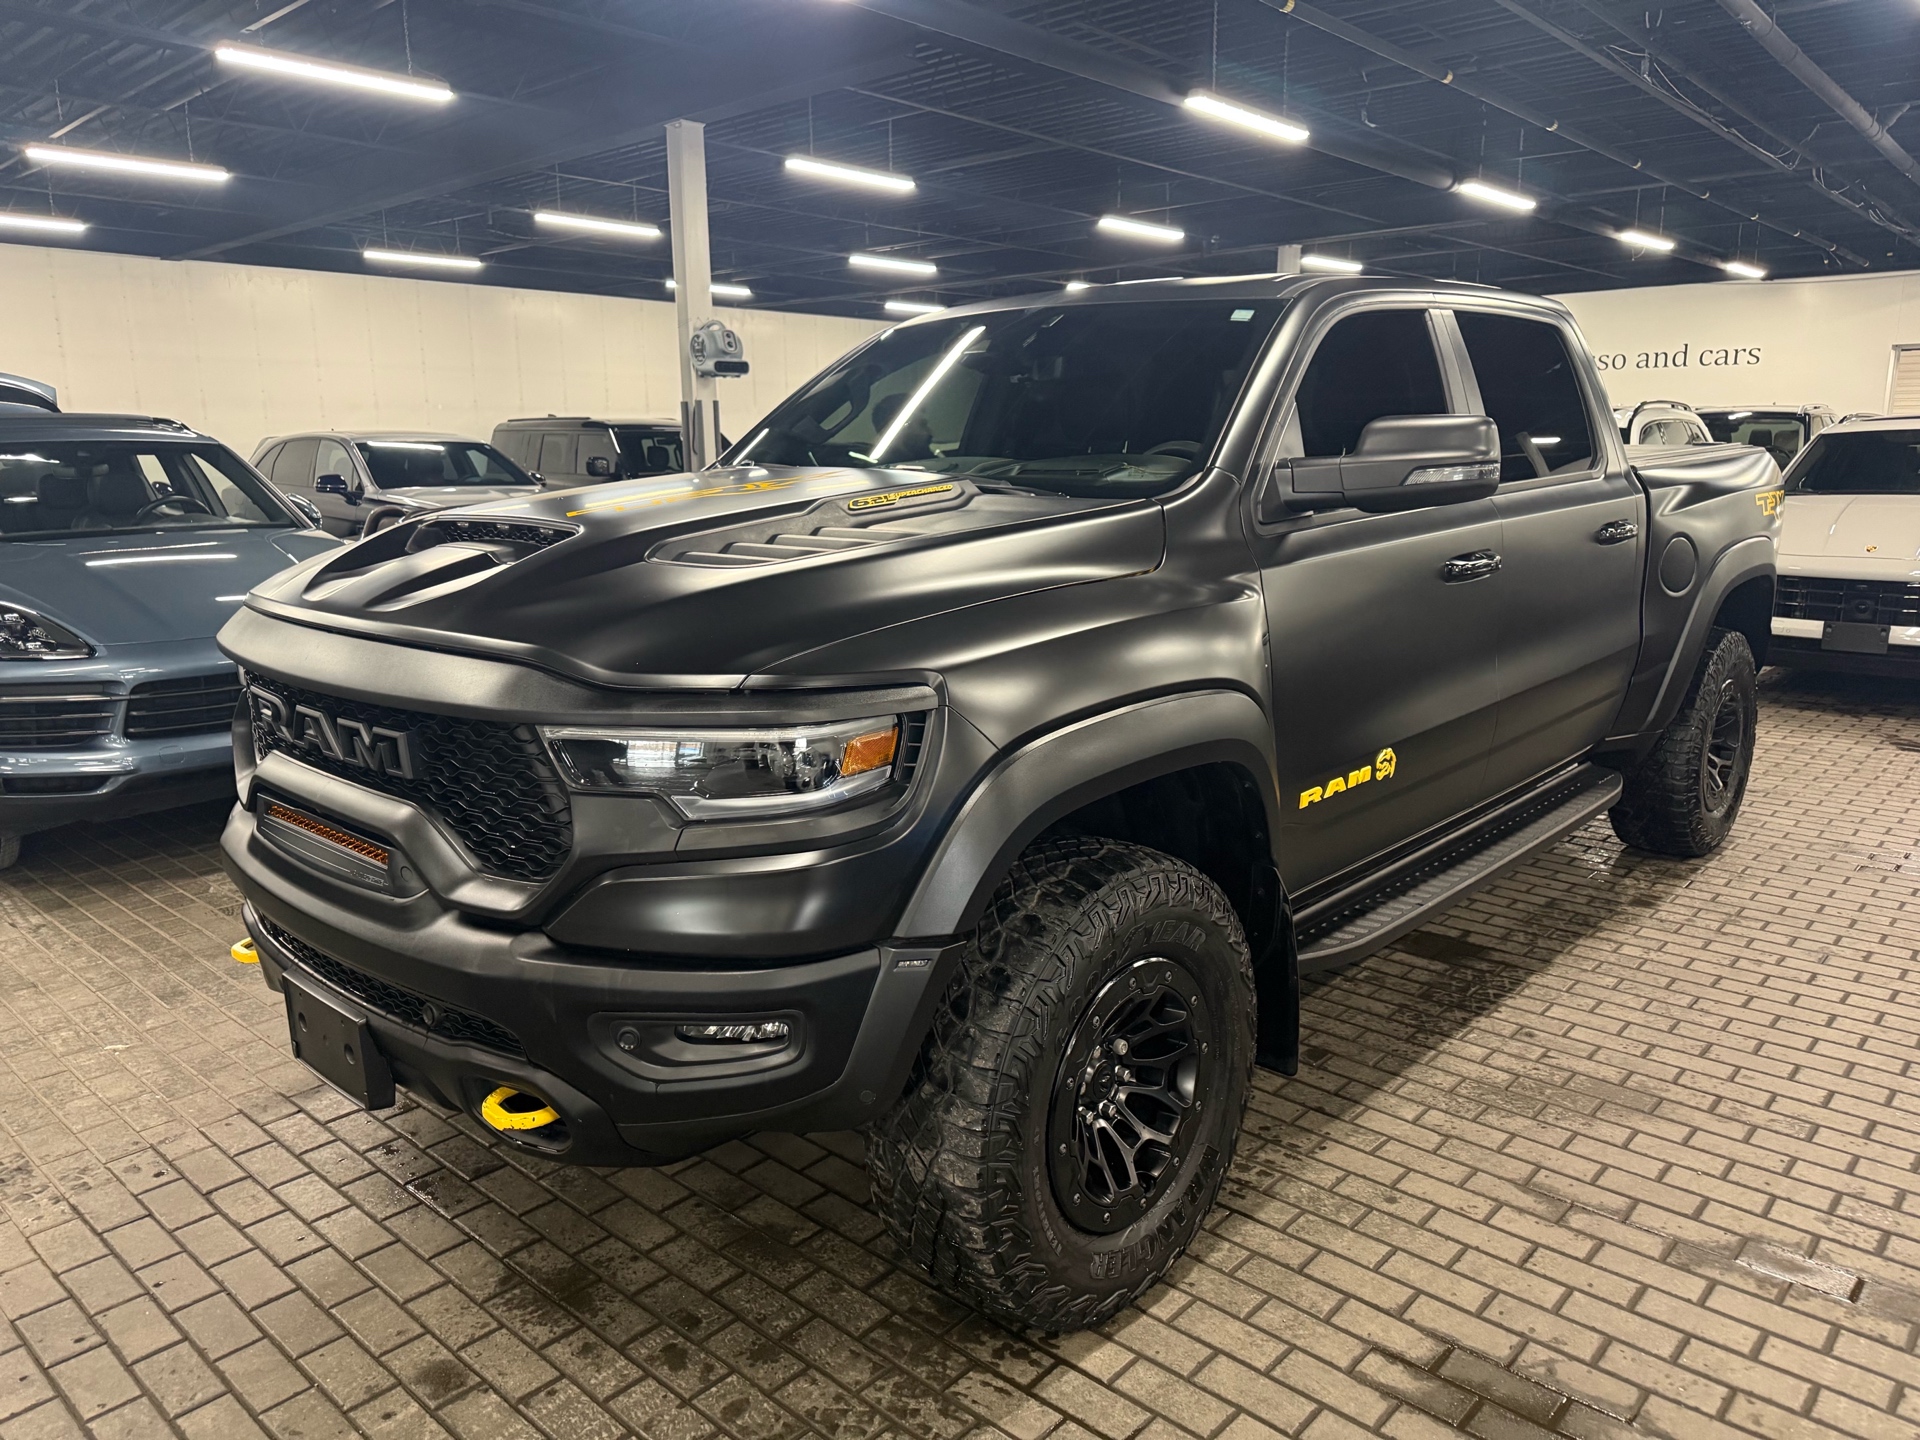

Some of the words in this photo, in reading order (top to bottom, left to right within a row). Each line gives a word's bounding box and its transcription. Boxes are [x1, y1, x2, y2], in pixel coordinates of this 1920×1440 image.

[1593, 353, 1627, 371] so
[1635, 343, 1689, 369] and
[1698, 345, 1762, 366] cars
[250, 685, 413, 779] RAM
[1299, 765, 1372, 809] RAM
